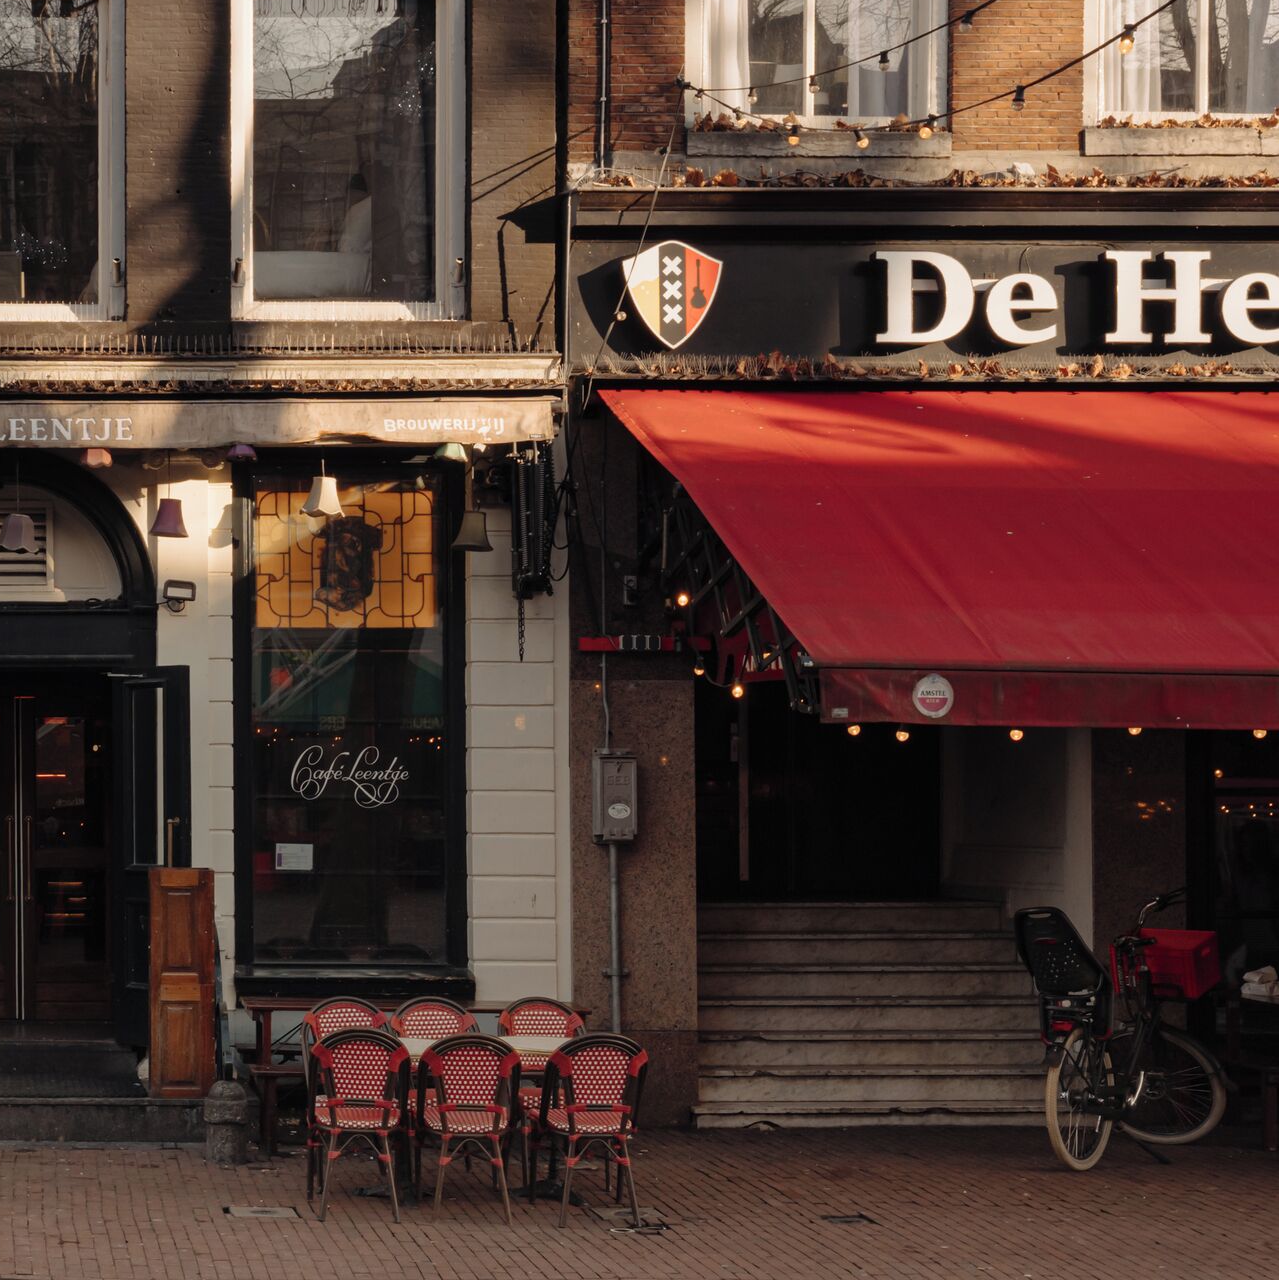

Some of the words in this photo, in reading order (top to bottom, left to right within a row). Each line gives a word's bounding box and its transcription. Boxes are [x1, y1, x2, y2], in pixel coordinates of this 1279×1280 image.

[875, 251, 1059, 344] De
[1104, 251, 1279, 344] He
[384, 418, 476, 432] BROUWERIJ
[290, 745, 350, 800] Café
[342, 745, 410, 809] Leentje
